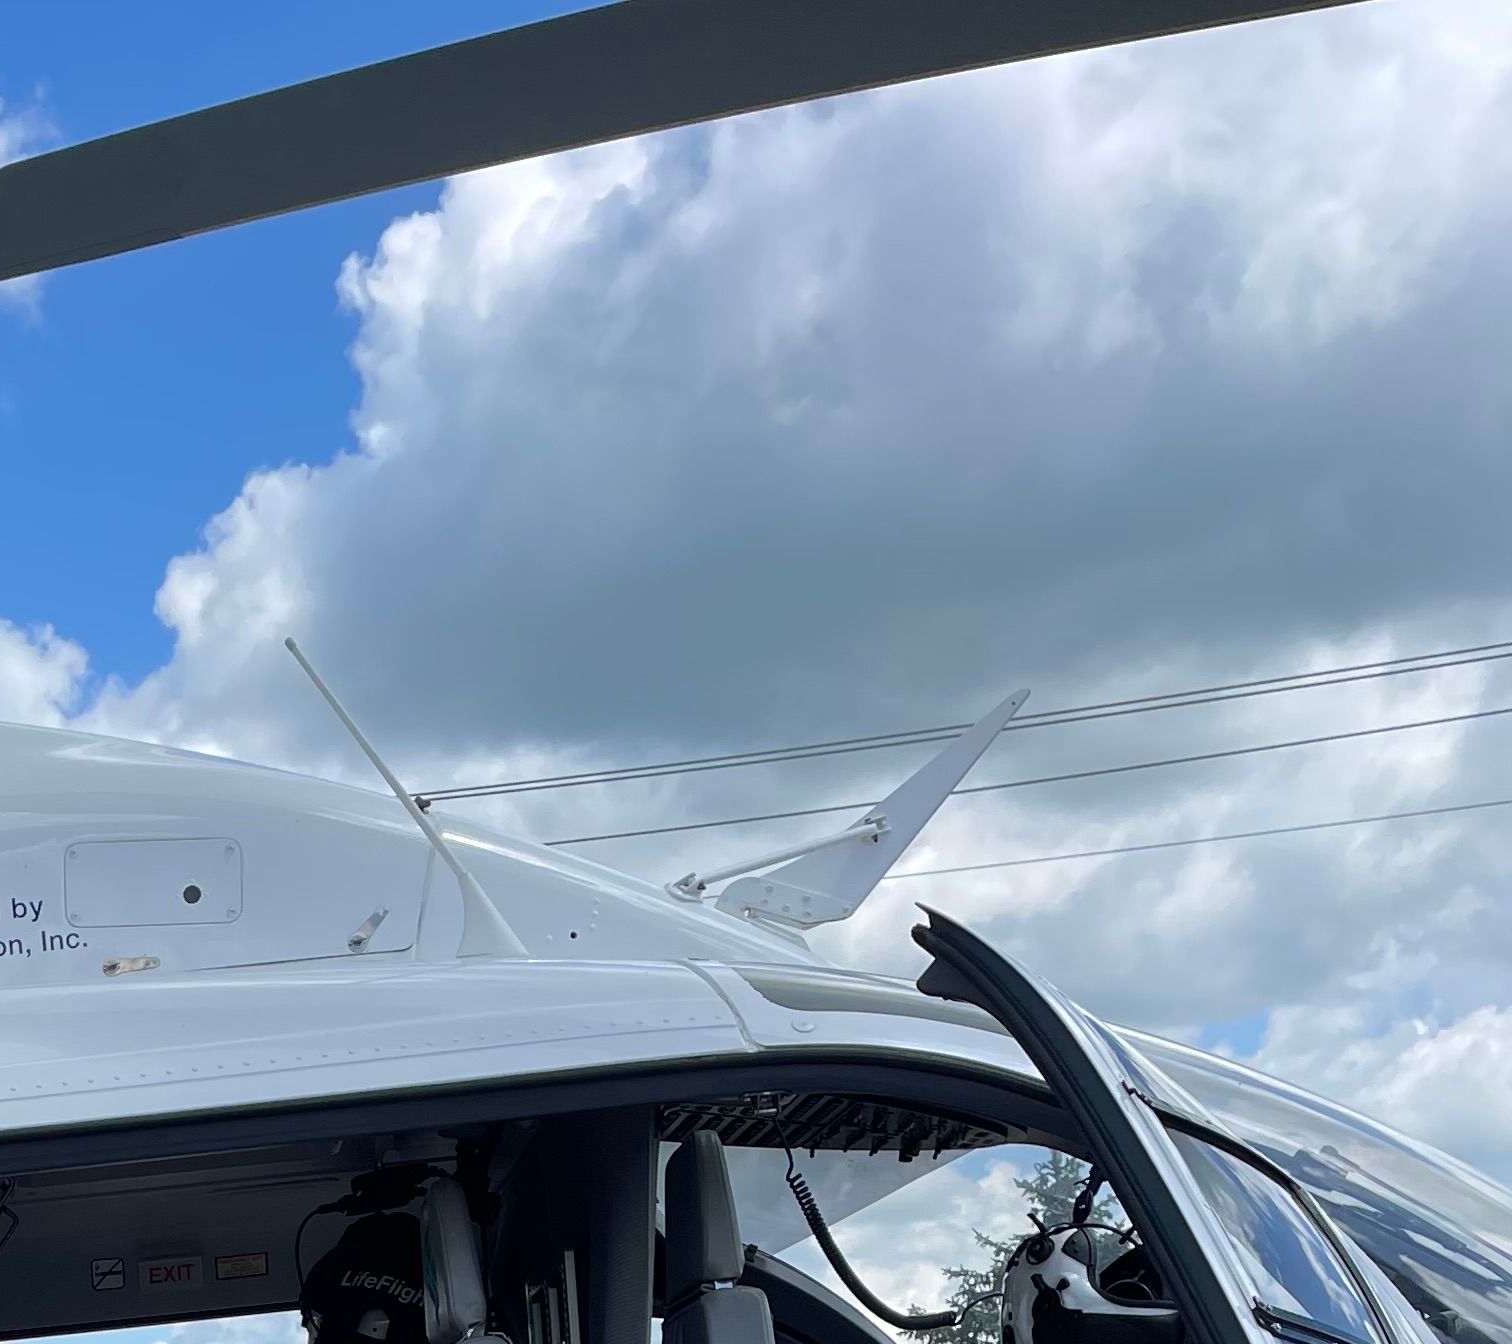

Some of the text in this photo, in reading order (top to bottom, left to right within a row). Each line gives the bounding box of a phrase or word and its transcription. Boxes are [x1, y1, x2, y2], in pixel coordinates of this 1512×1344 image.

[12, 897, 44, 922] by
[41, 930, 88, 952] Inc.
[149, 1263, 194, 1284] EXIT
[340, 1269, 424, 1307] LifeFligh
